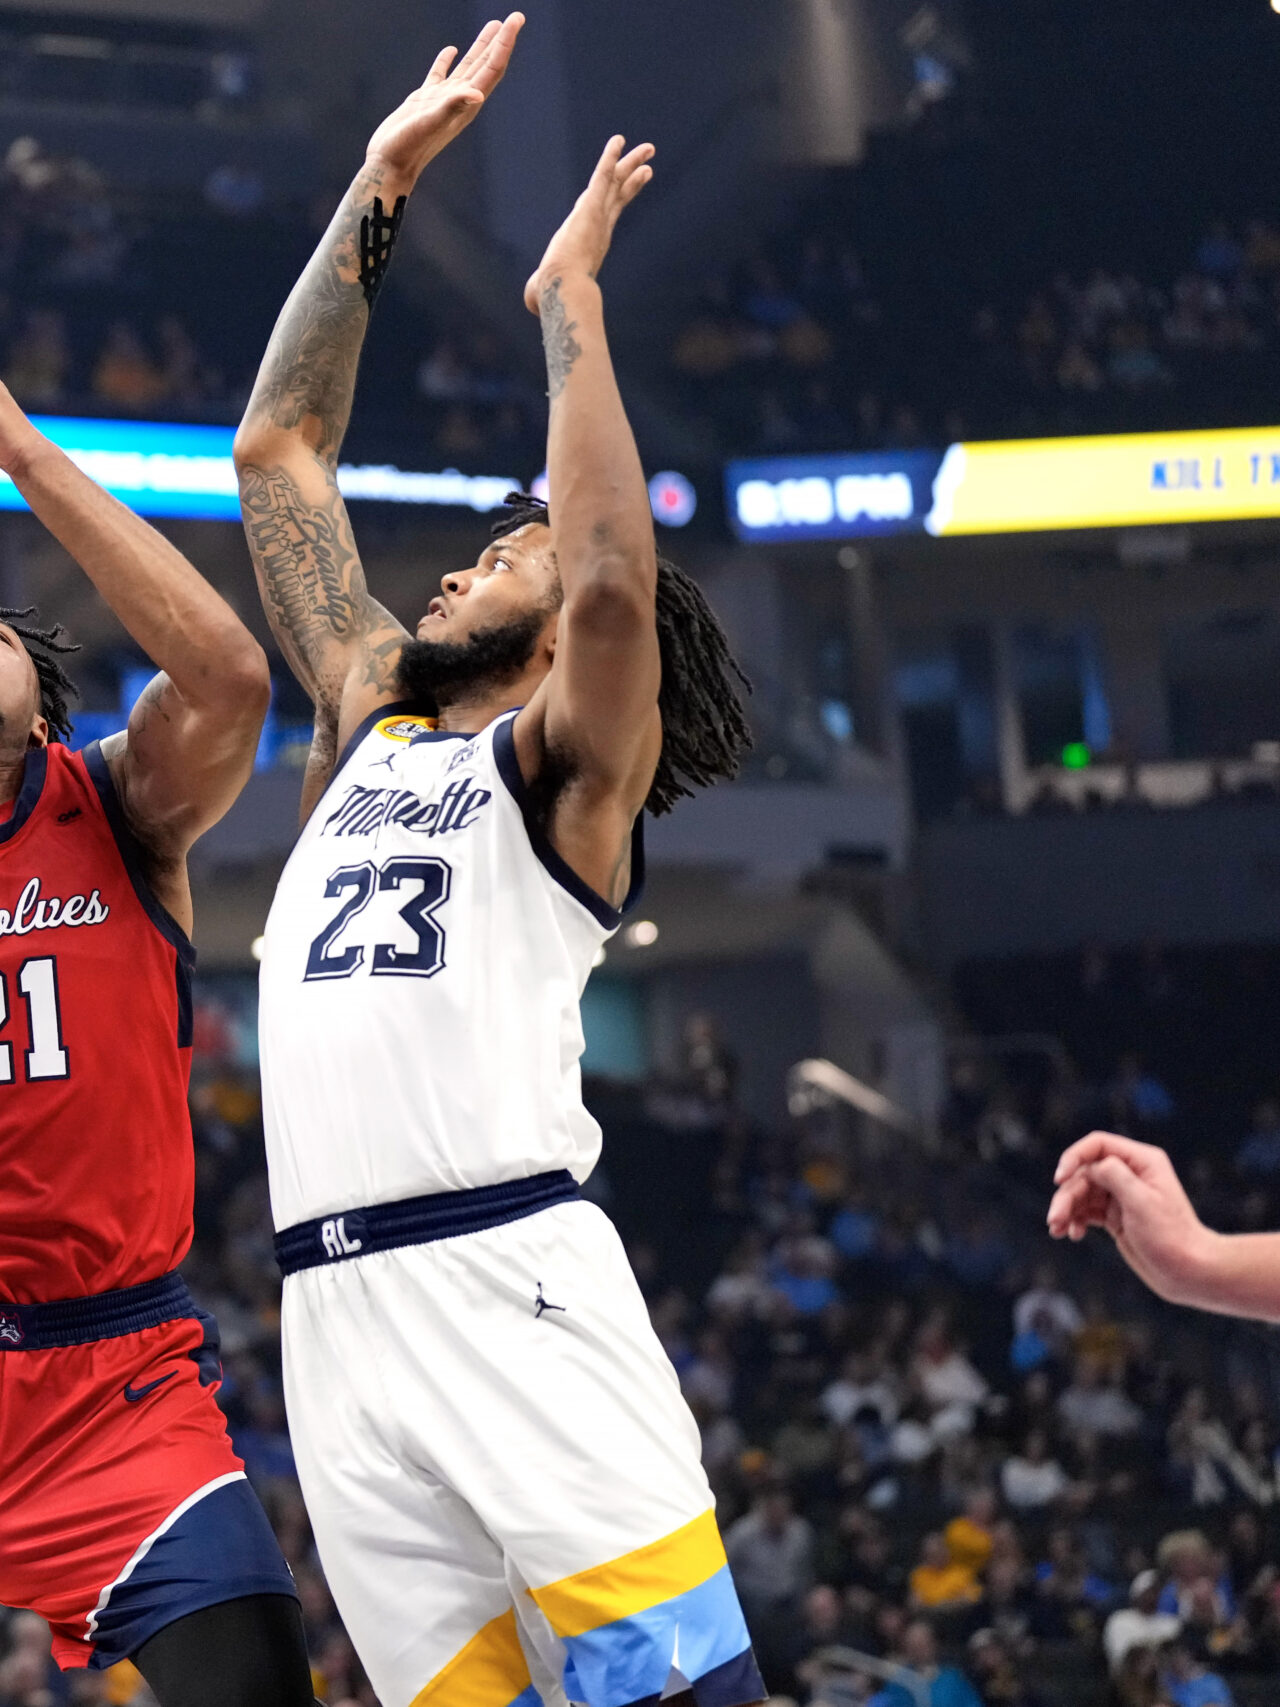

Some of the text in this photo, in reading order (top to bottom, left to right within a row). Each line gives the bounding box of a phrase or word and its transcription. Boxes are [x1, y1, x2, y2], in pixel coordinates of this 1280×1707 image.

[288, 508, 359, 634] Beauty
[320, 776, 492, 850] Mauette
[302, 855, 453, 982] 23
[321, 1217, 362, 1258] AL
